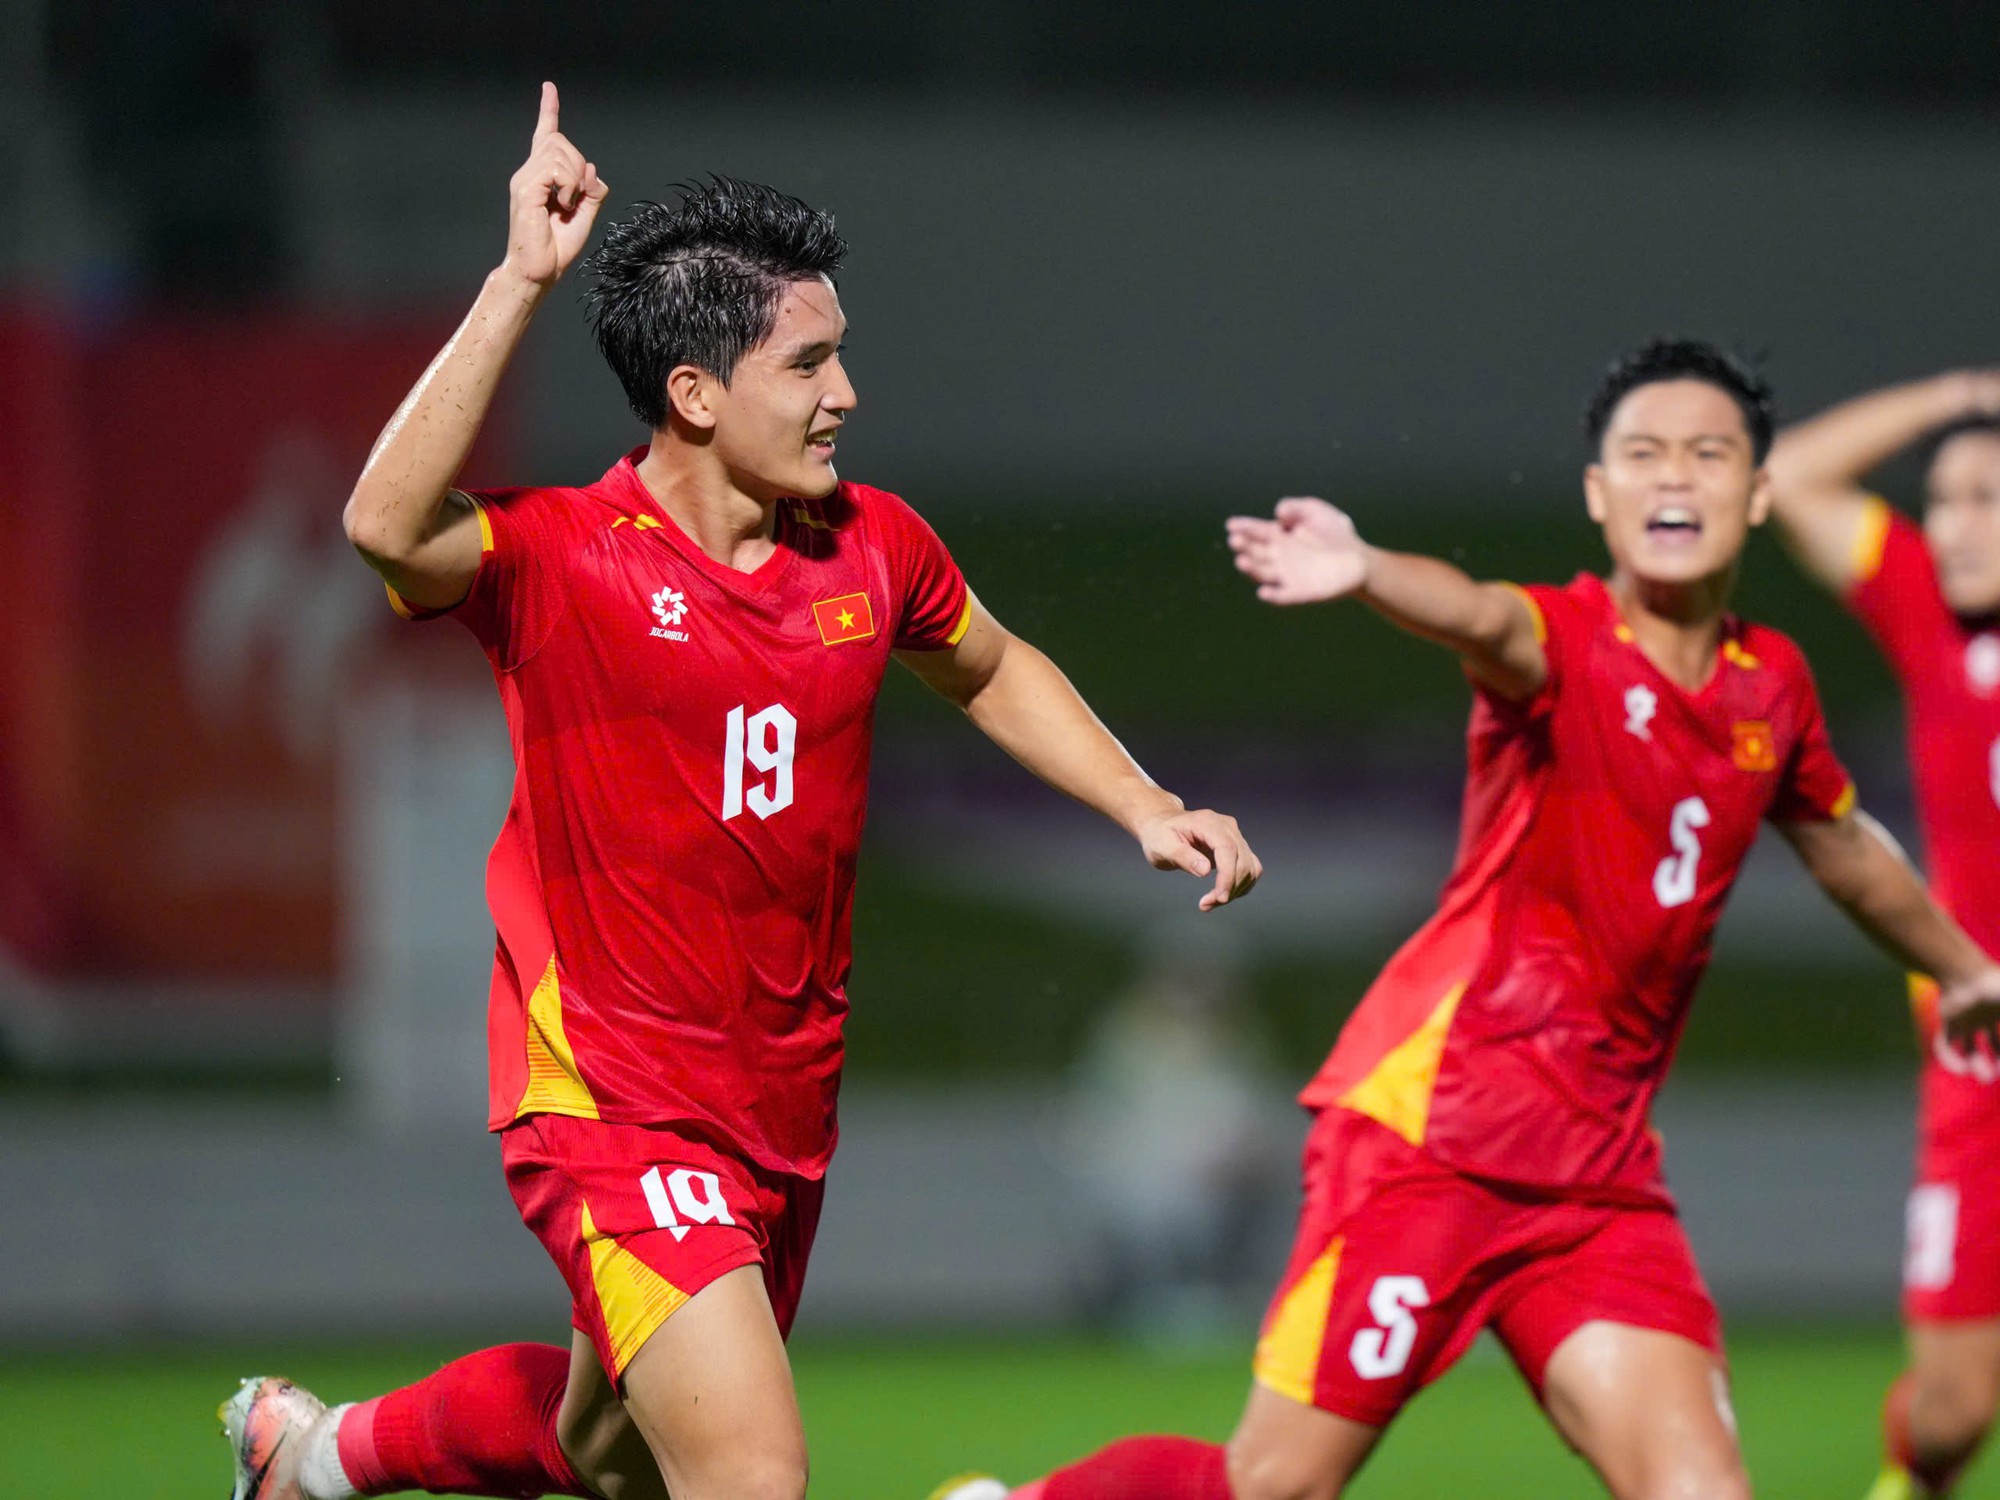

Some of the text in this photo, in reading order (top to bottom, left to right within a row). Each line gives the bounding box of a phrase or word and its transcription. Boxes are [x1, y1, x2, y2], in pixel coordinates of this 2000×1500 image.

[722, 703, 797, 821] 19
[1653, 796, 1710, 909] 5
[639, 1165, 735, 1243] 19
[1349, 1275, 1431, 1381] 5
